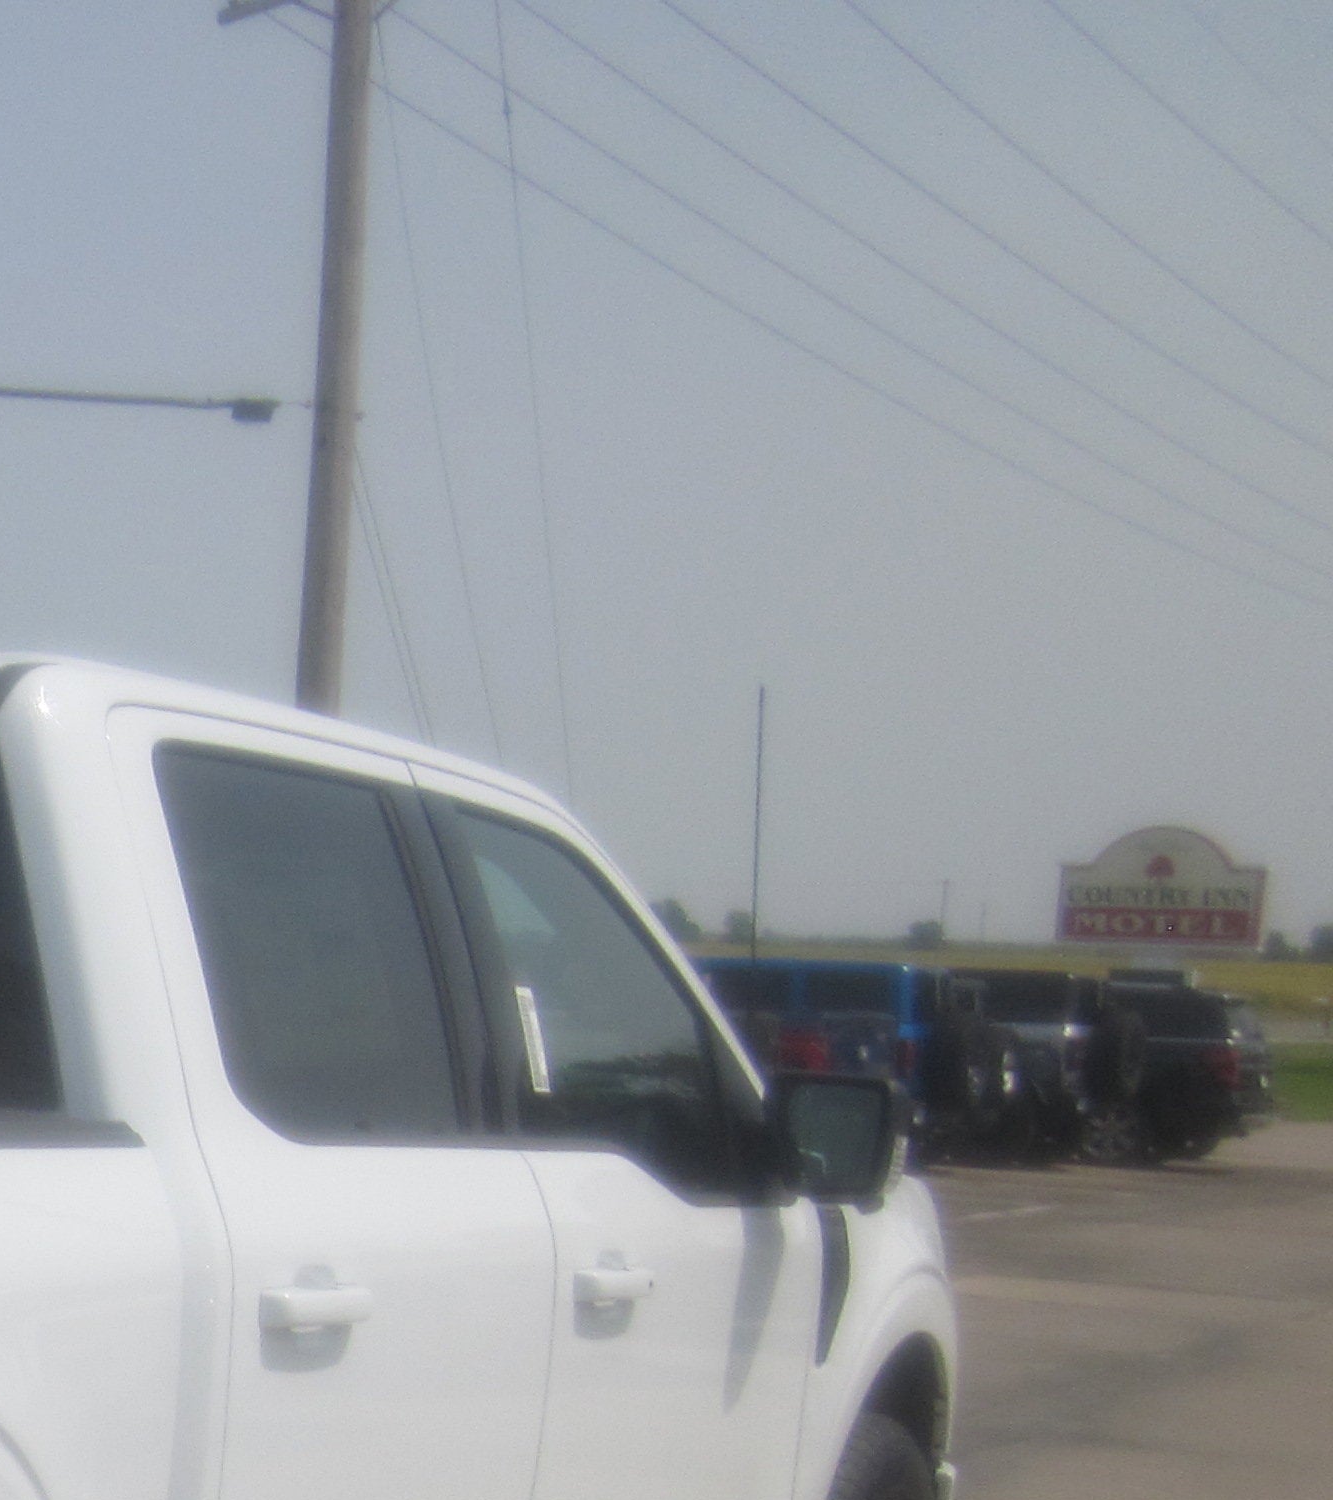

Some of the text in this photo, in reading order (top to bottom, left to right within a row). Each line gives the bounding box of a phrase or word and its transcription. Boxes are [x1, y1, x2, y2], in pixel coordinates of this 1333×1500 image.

[1068, 886, 1250, 907] COUNTRY INN
[1074, 912, 1234, 935] MOTEL
